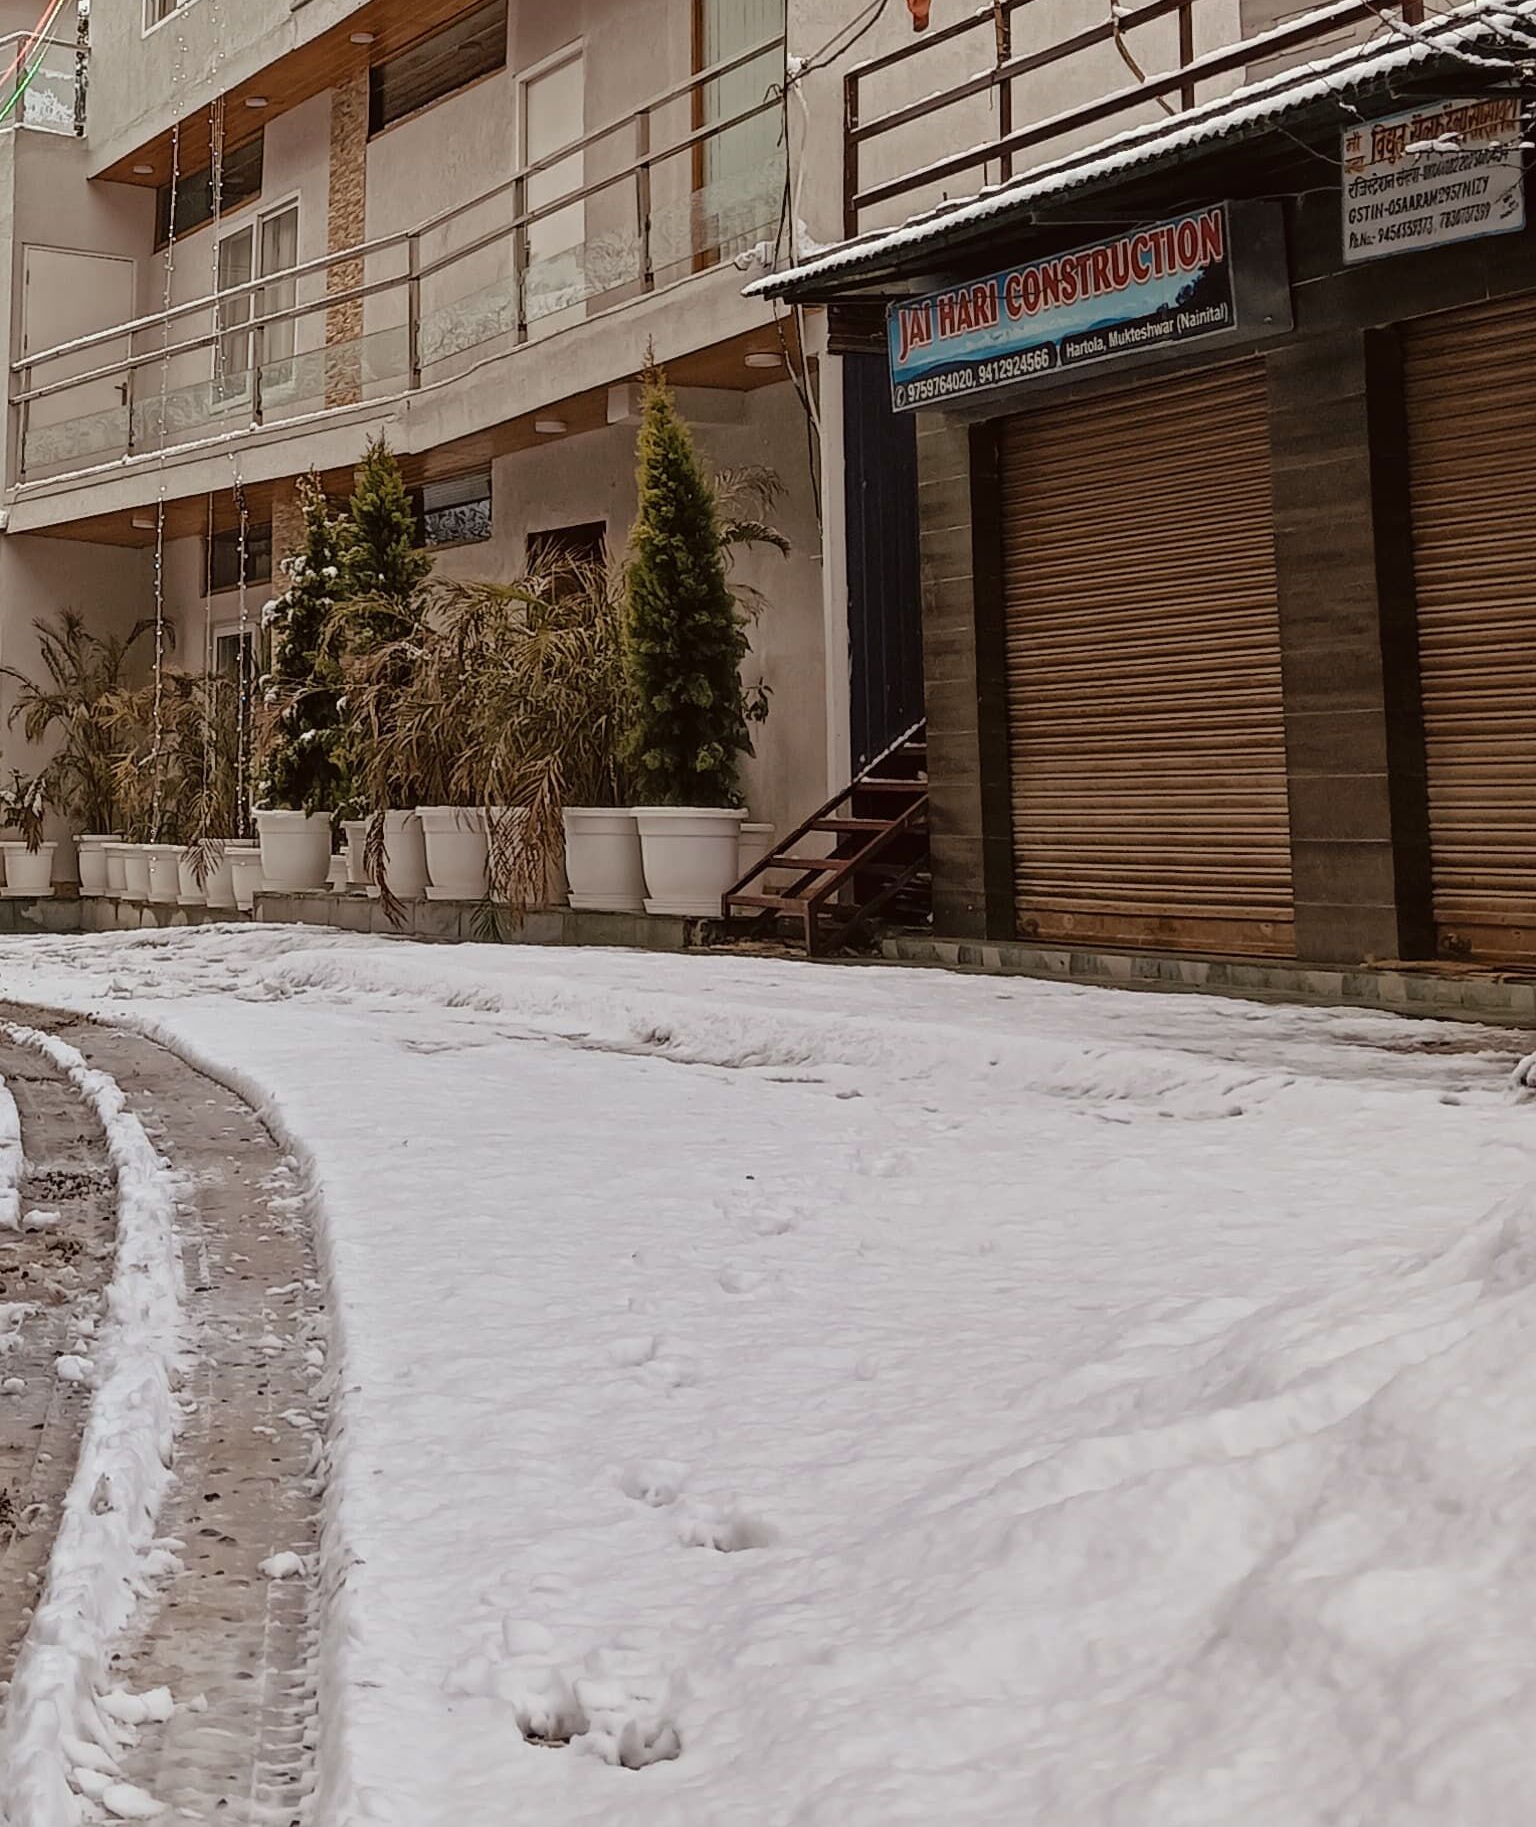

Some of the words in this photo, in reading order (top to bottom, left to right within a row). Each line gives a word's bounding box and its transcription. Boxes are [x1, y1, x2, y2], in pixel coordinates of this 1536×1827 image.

[896, 301, 933, 364] JAI
[937, 279, 1000, 341] HARI
[1004, 208, 1225, 321] CONSTRUCTION
[1108, 318, 1175, 350] Mukteshwar
[1177, 301, 1229, 335] (Nainital)
[978, 347, 1051, 386] 9412924566
